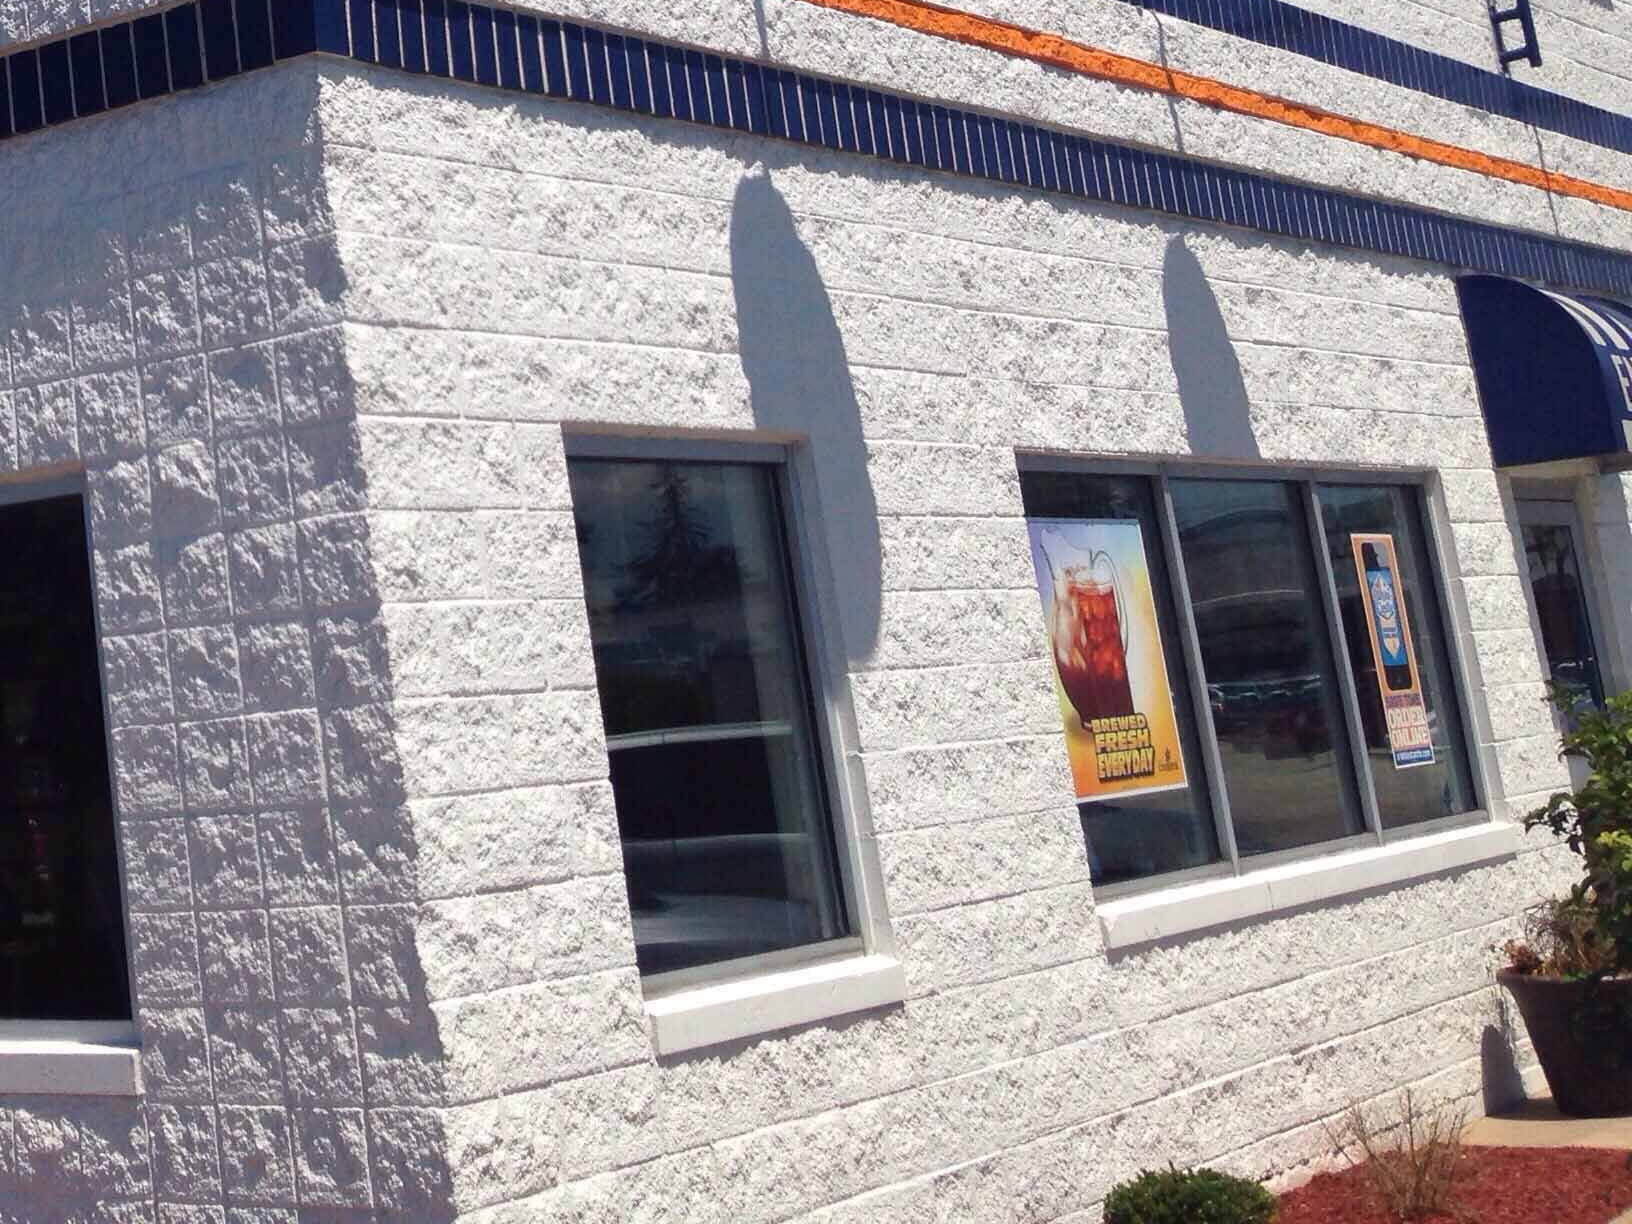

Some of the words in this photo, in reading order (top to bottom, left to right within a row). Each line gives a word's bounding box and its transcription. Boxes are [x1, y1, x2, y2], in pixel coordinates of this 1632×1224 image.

[1090, 713, 1147, 733] BREWED
[1095, 728, 1150, 753] FRESH
[1097, 746, 1155, 780] EVERYDAY
